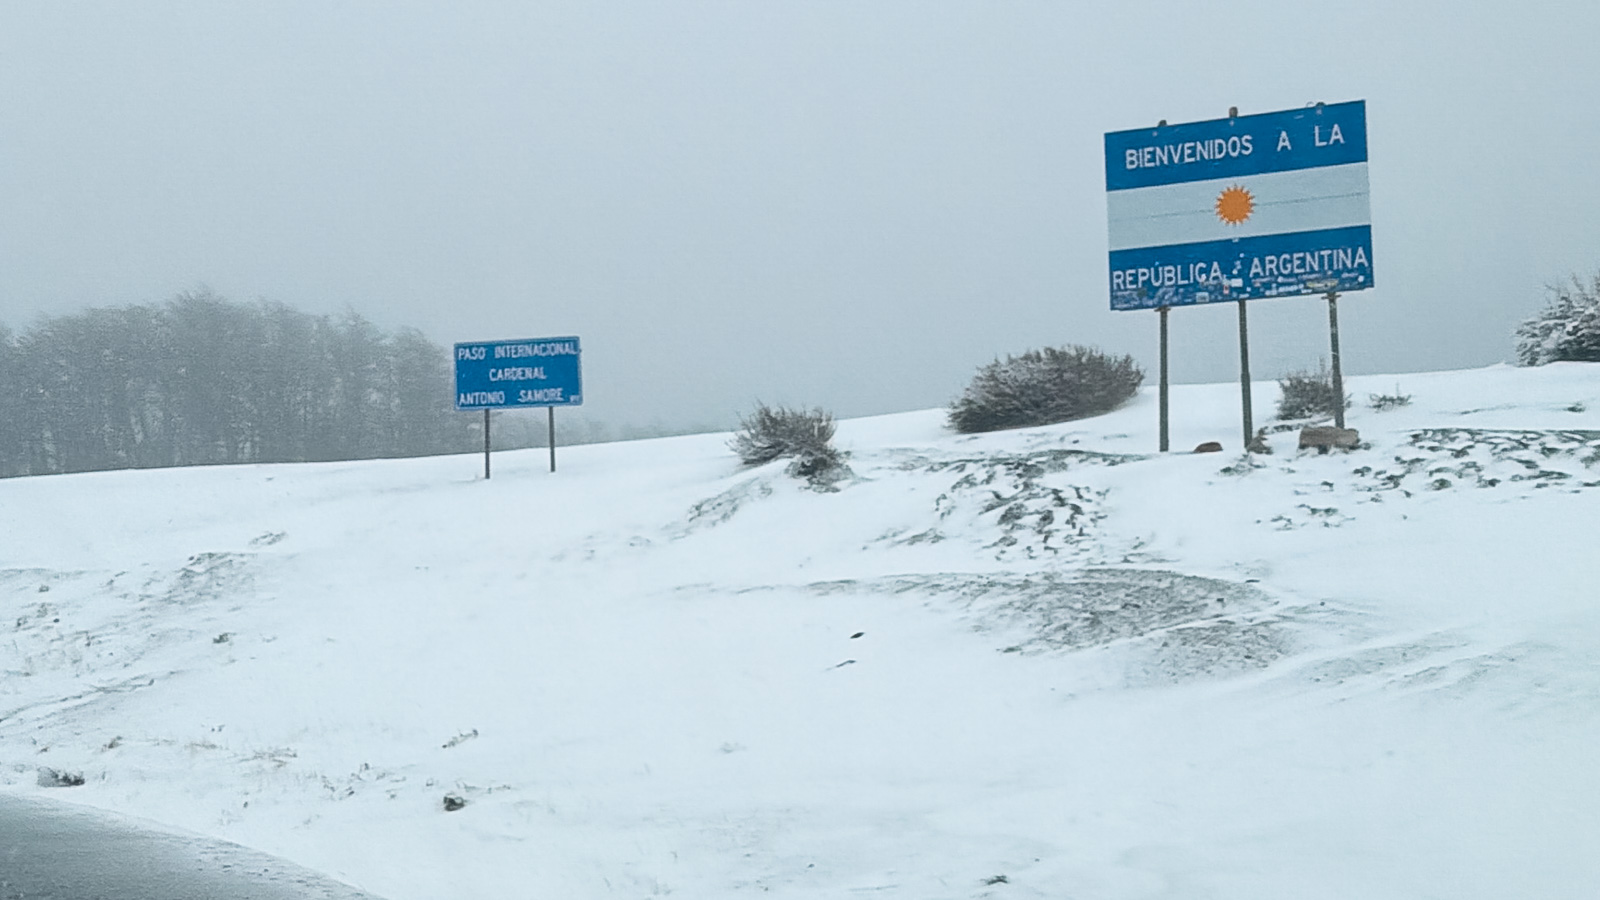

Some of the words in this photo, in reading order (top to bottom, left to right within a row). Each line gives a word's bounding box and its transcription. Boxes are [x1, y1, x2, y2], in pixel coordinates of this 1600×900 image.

[1125, 135, 1253, 169] BIENVENIDOS
[1277, 131, 1291, 152] A
[1315, 123, 1344, 147] LA
[1113, 261, 1222, 290] REPÚBLICA
[1249, 246, 1368, 277] ARGENTINA
[458, 347, 486, 360] PASO
[495, 342, 577, 358] INTERNACIONAL
[489, 367, 546, 381] CARDENAL
[459, 391, 505, 405] ANTONIO
